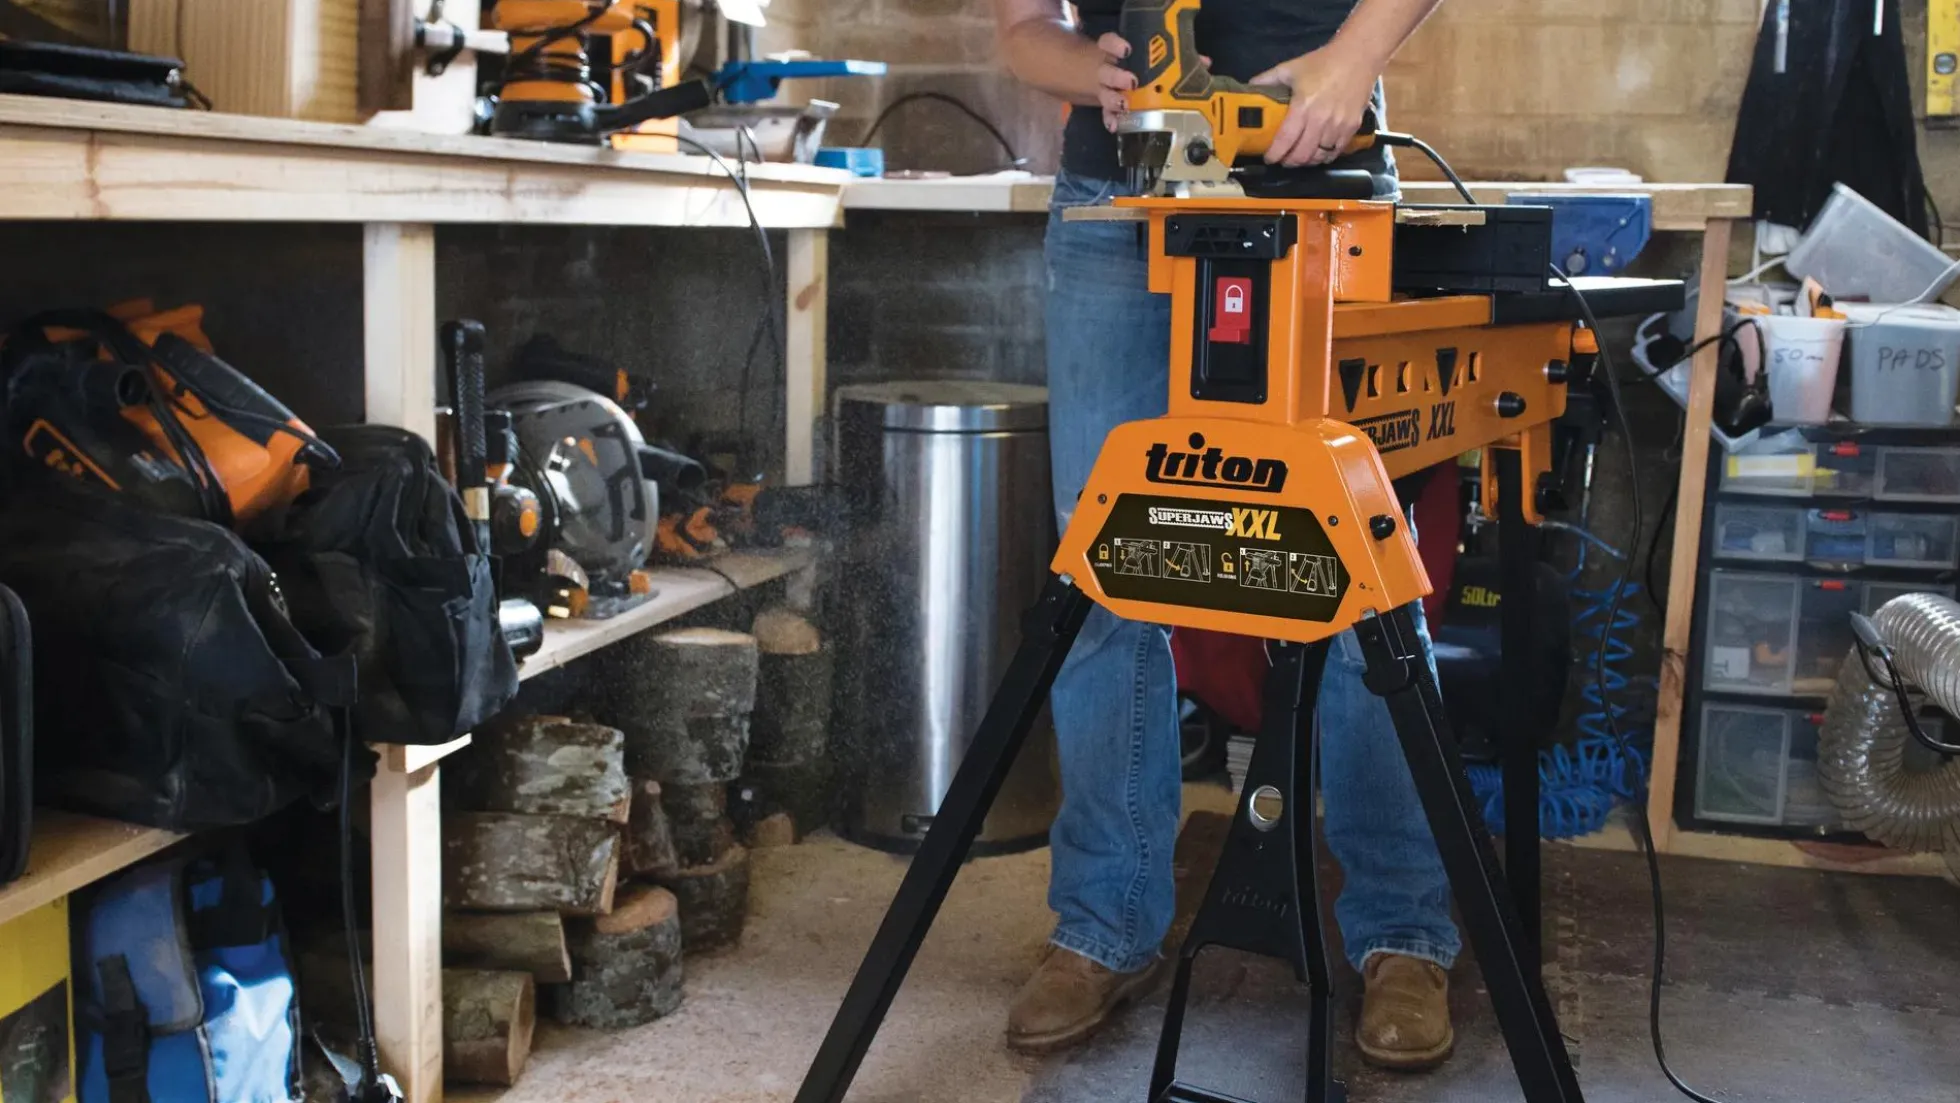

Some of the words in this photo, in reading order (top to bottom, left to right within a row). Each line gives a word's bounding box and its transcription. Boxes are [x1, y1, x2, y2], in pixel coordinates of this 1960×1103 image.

[1877, 346, 1946, 372] PADS
[1426, 401, 1456, 441] XXL
[1146, 432, 1288, 493] triton
[1149, 507, 1233, 530] SUPERJAWS
[1225, 507, 1282, 541] XXL
